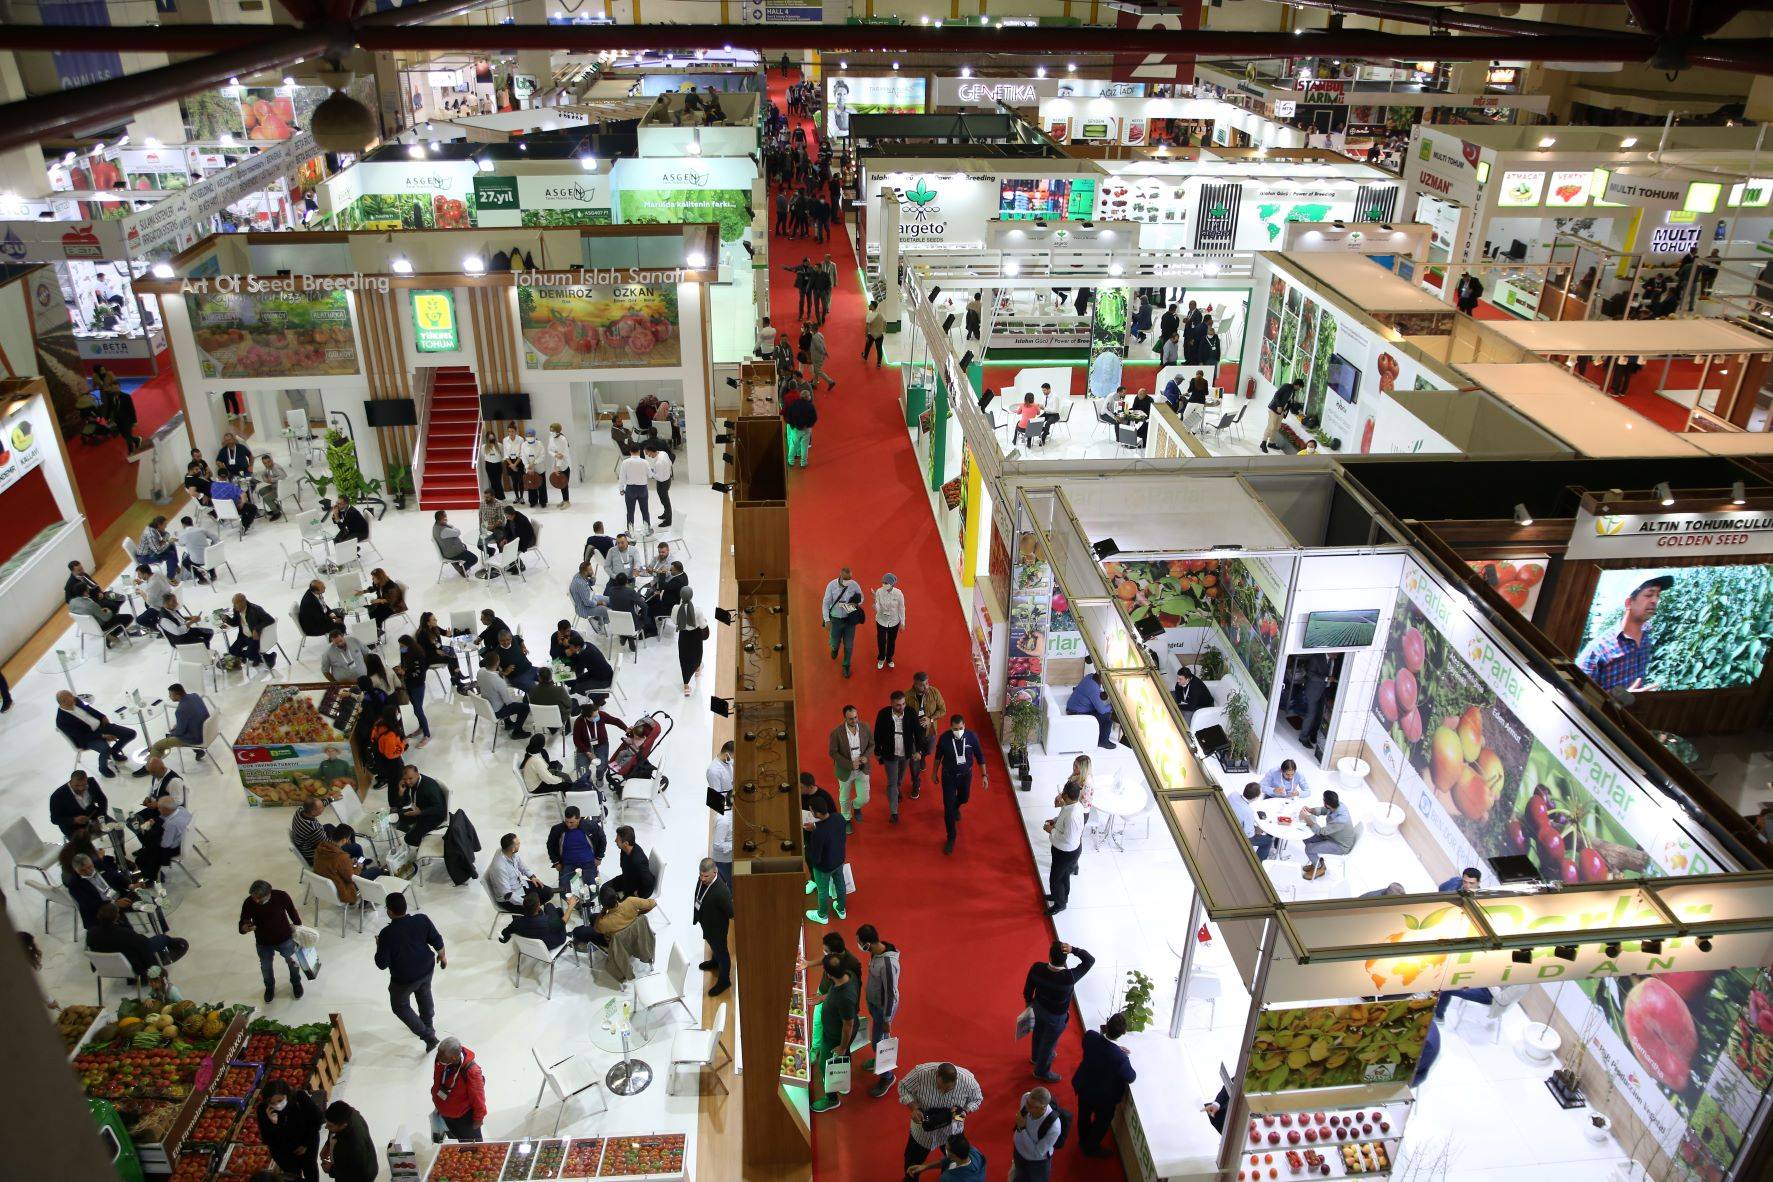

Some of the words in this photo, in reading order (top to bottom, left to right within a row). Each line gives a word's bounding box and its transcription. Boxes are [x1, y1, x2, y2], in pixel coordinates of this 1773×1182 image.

[406, 177, 441, 185] ASGEN
[662, 173, 698, 182] ASGEN
[1419, 171, 1450, 194] UZMAN
[545, 188, 583, 197] ASGEN
[1609, 182, 1636, 196] MULTİ
[1638, 187, 1680, 200] TOHUM
[1654, 226, 1702, 241] MULTİ
[1652, 242, 1697, 252] TOHUM
[180, 276, 208, 293] Art
[214, 274, 241, 293] Of
[247, 273, 295, 293] Seed
[302, 272, 389, 293] Breeding
[511, 269, 572, 286] Tohum
[580, 268, 621, 284] Islah
[102, 343, 128, 351] BETA
[1639, 521, 1680, 532] ALTIN
[1656, 535, 1713, 547] GOLDEN
[1716, 534, 1749, 545] SEED
[1482, 643, 1526, 701] Parlar
[1576, 742, 1636, 813] Parlar
